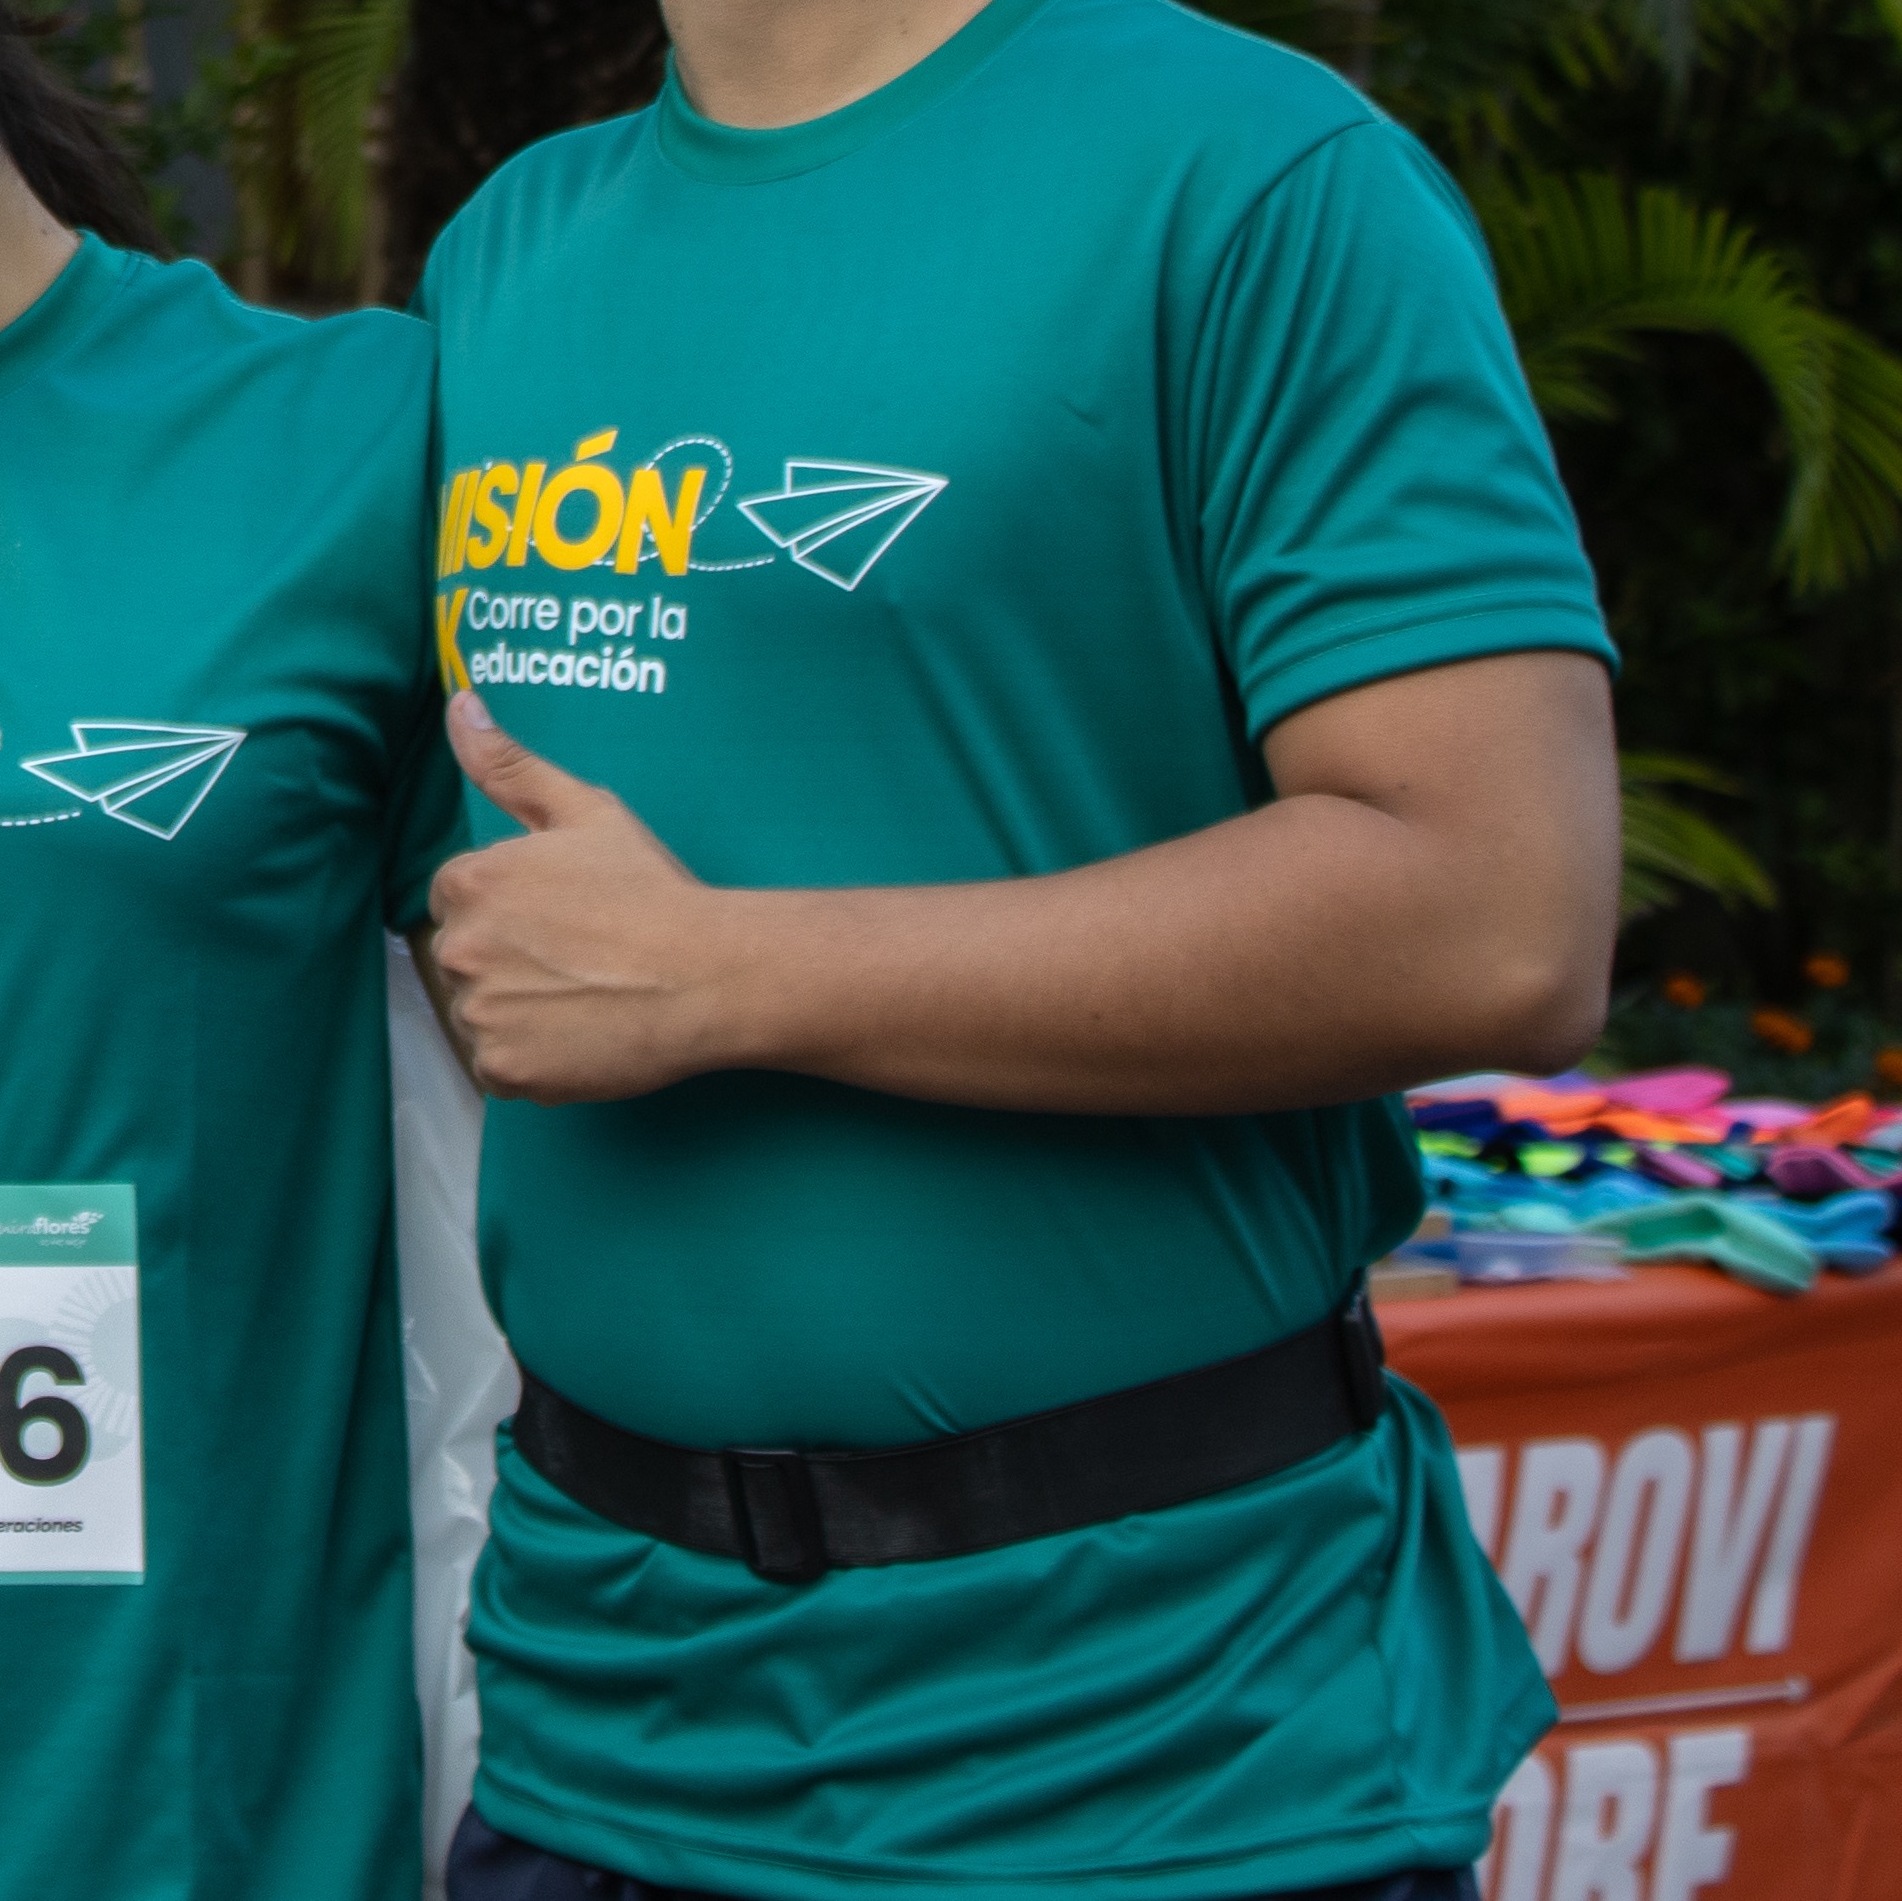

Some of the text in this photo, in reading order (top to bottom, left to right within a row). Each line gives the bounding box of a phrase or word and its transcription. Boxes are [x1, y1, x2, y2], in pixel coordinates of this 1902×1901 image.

[467, 590, 687, 646] Corre por la
[470, 642, 666, 694] educación
[1453, 1414, 1836, 1678] ROVI
